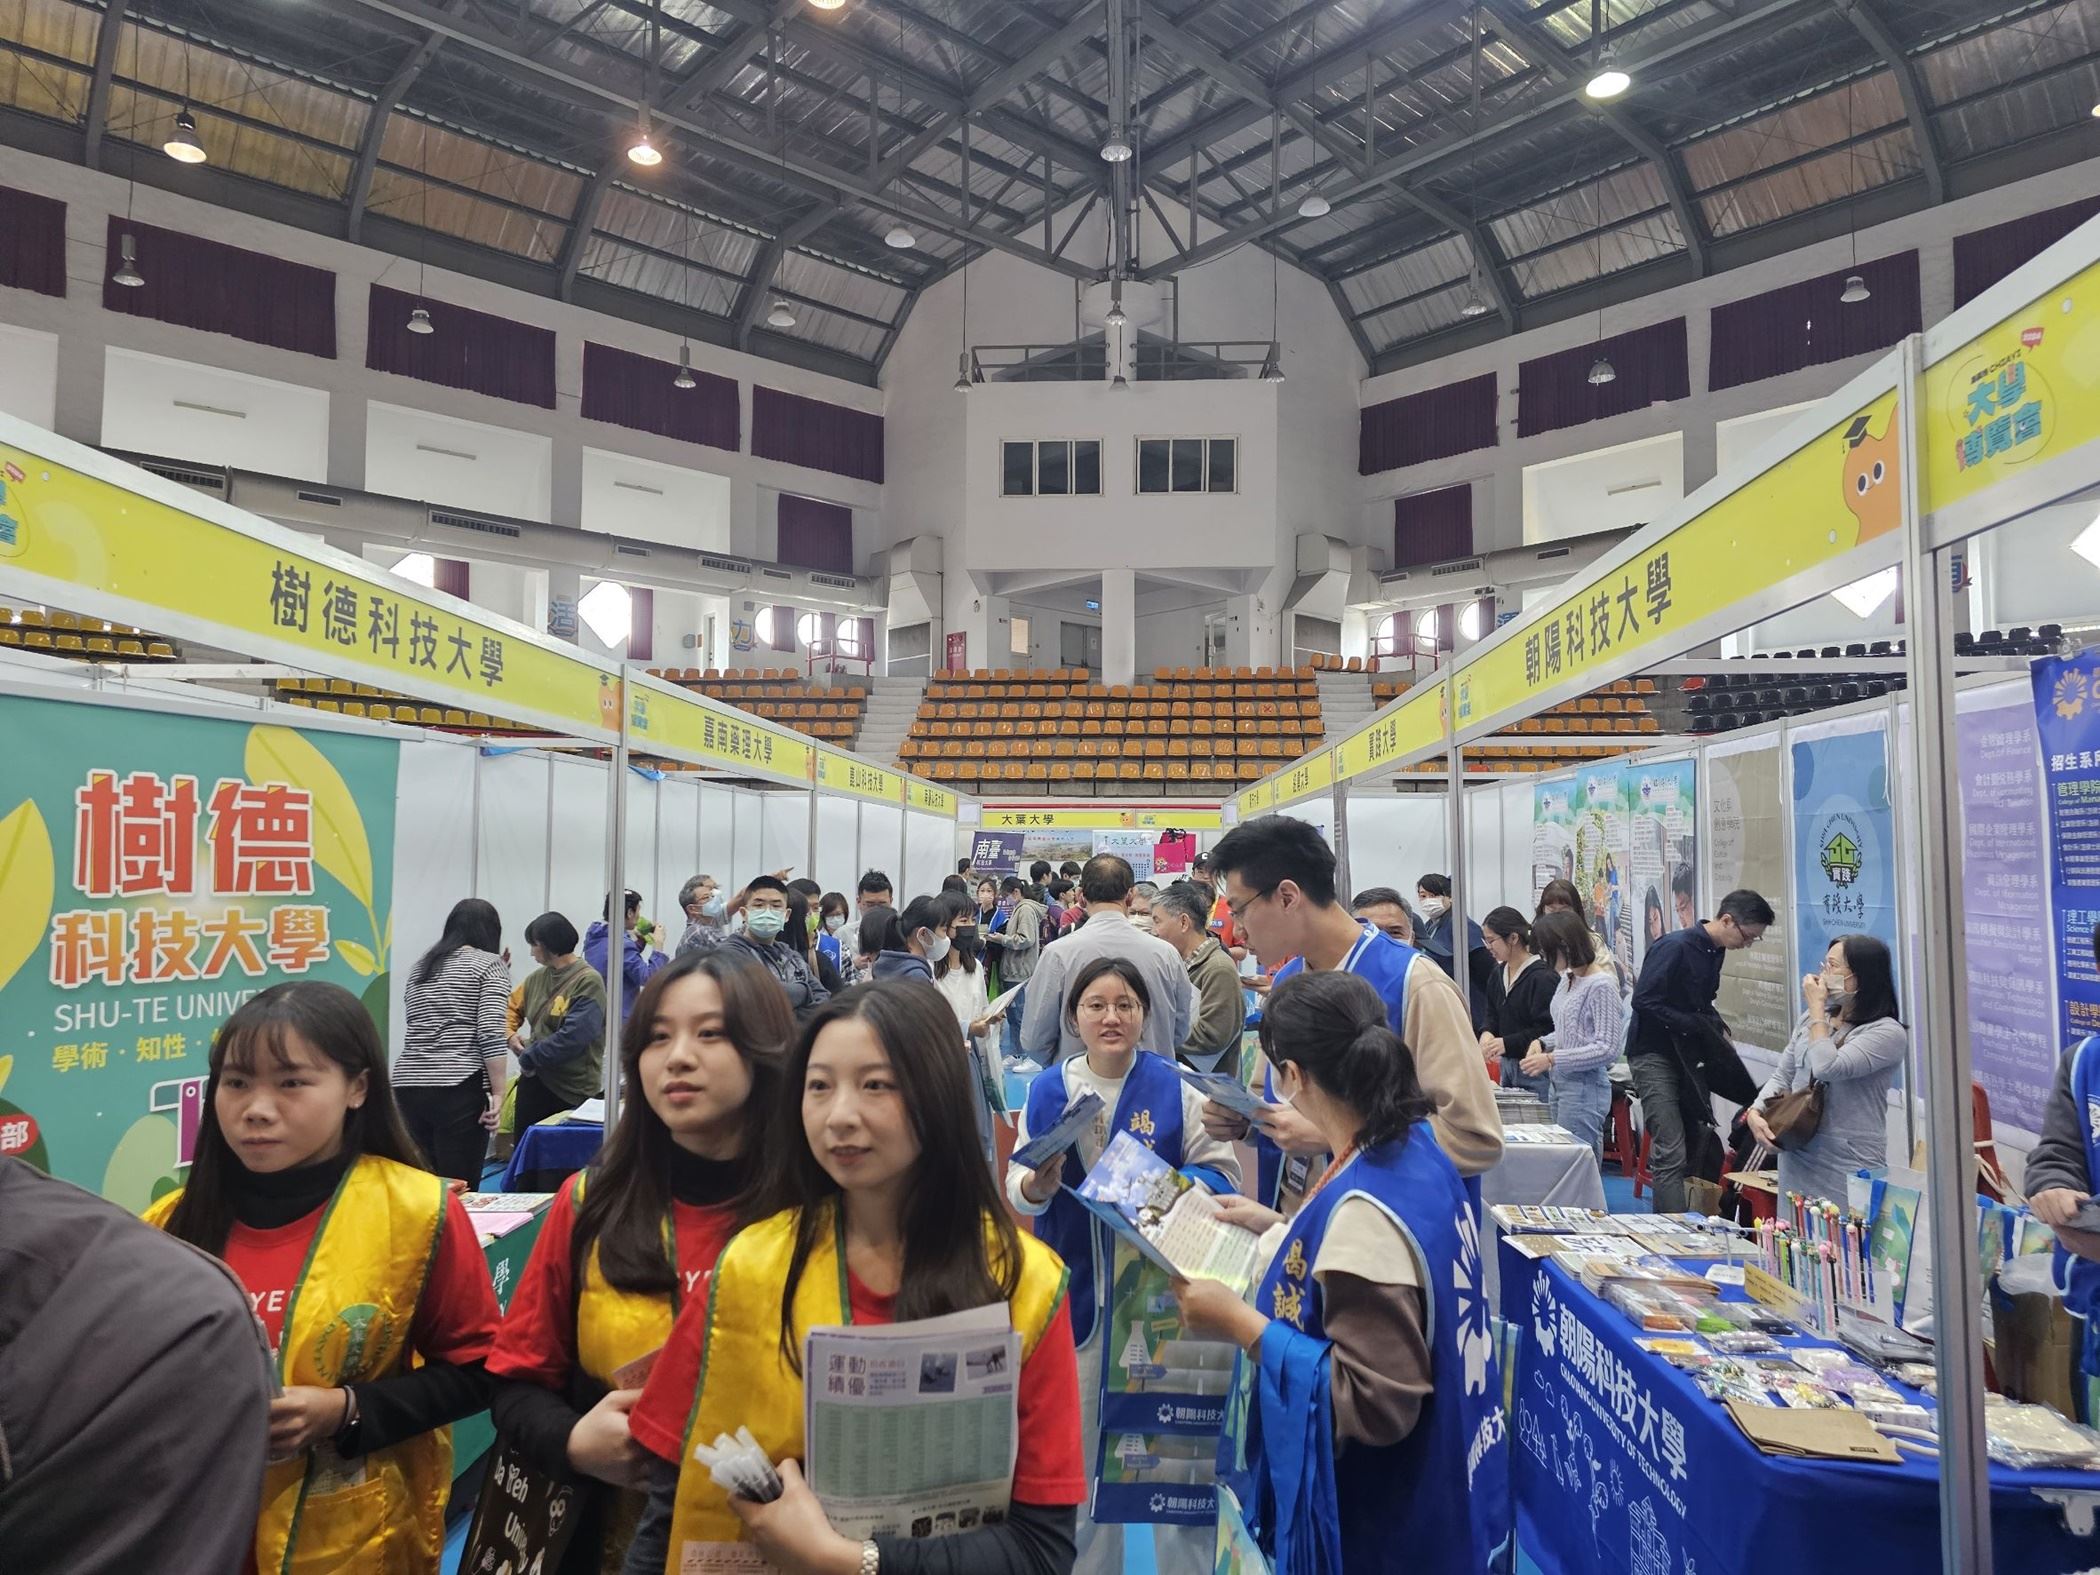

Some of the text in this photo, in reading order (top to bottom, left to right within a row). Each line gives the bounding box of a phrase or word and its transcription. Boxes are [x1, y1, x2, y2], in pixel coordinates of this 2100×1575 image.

[270, 559, 505, 688] 樹德科技大學
[1525, 551, 1672, 687] 朝陽科技大學
[73, 769, 316, 898] 樹德
[1001, 814, 1055, 826] 大葉大學
[972, 839, 1003, 866] 南臺
[2066, 910, 2100, 925] 理工學
[49, 905, 330, 989] 科技大學
[54, 988, 262, 1033] SHU-TE UNIVE
[2069, 1001, 2100, 1017] 設計學
[251, 1290, 294, 1312] YE
[1560, 1302, 1687, 1480] 朝陽科技大學
[1637, 1449, 1687, 1520] TECHNOLOGY
